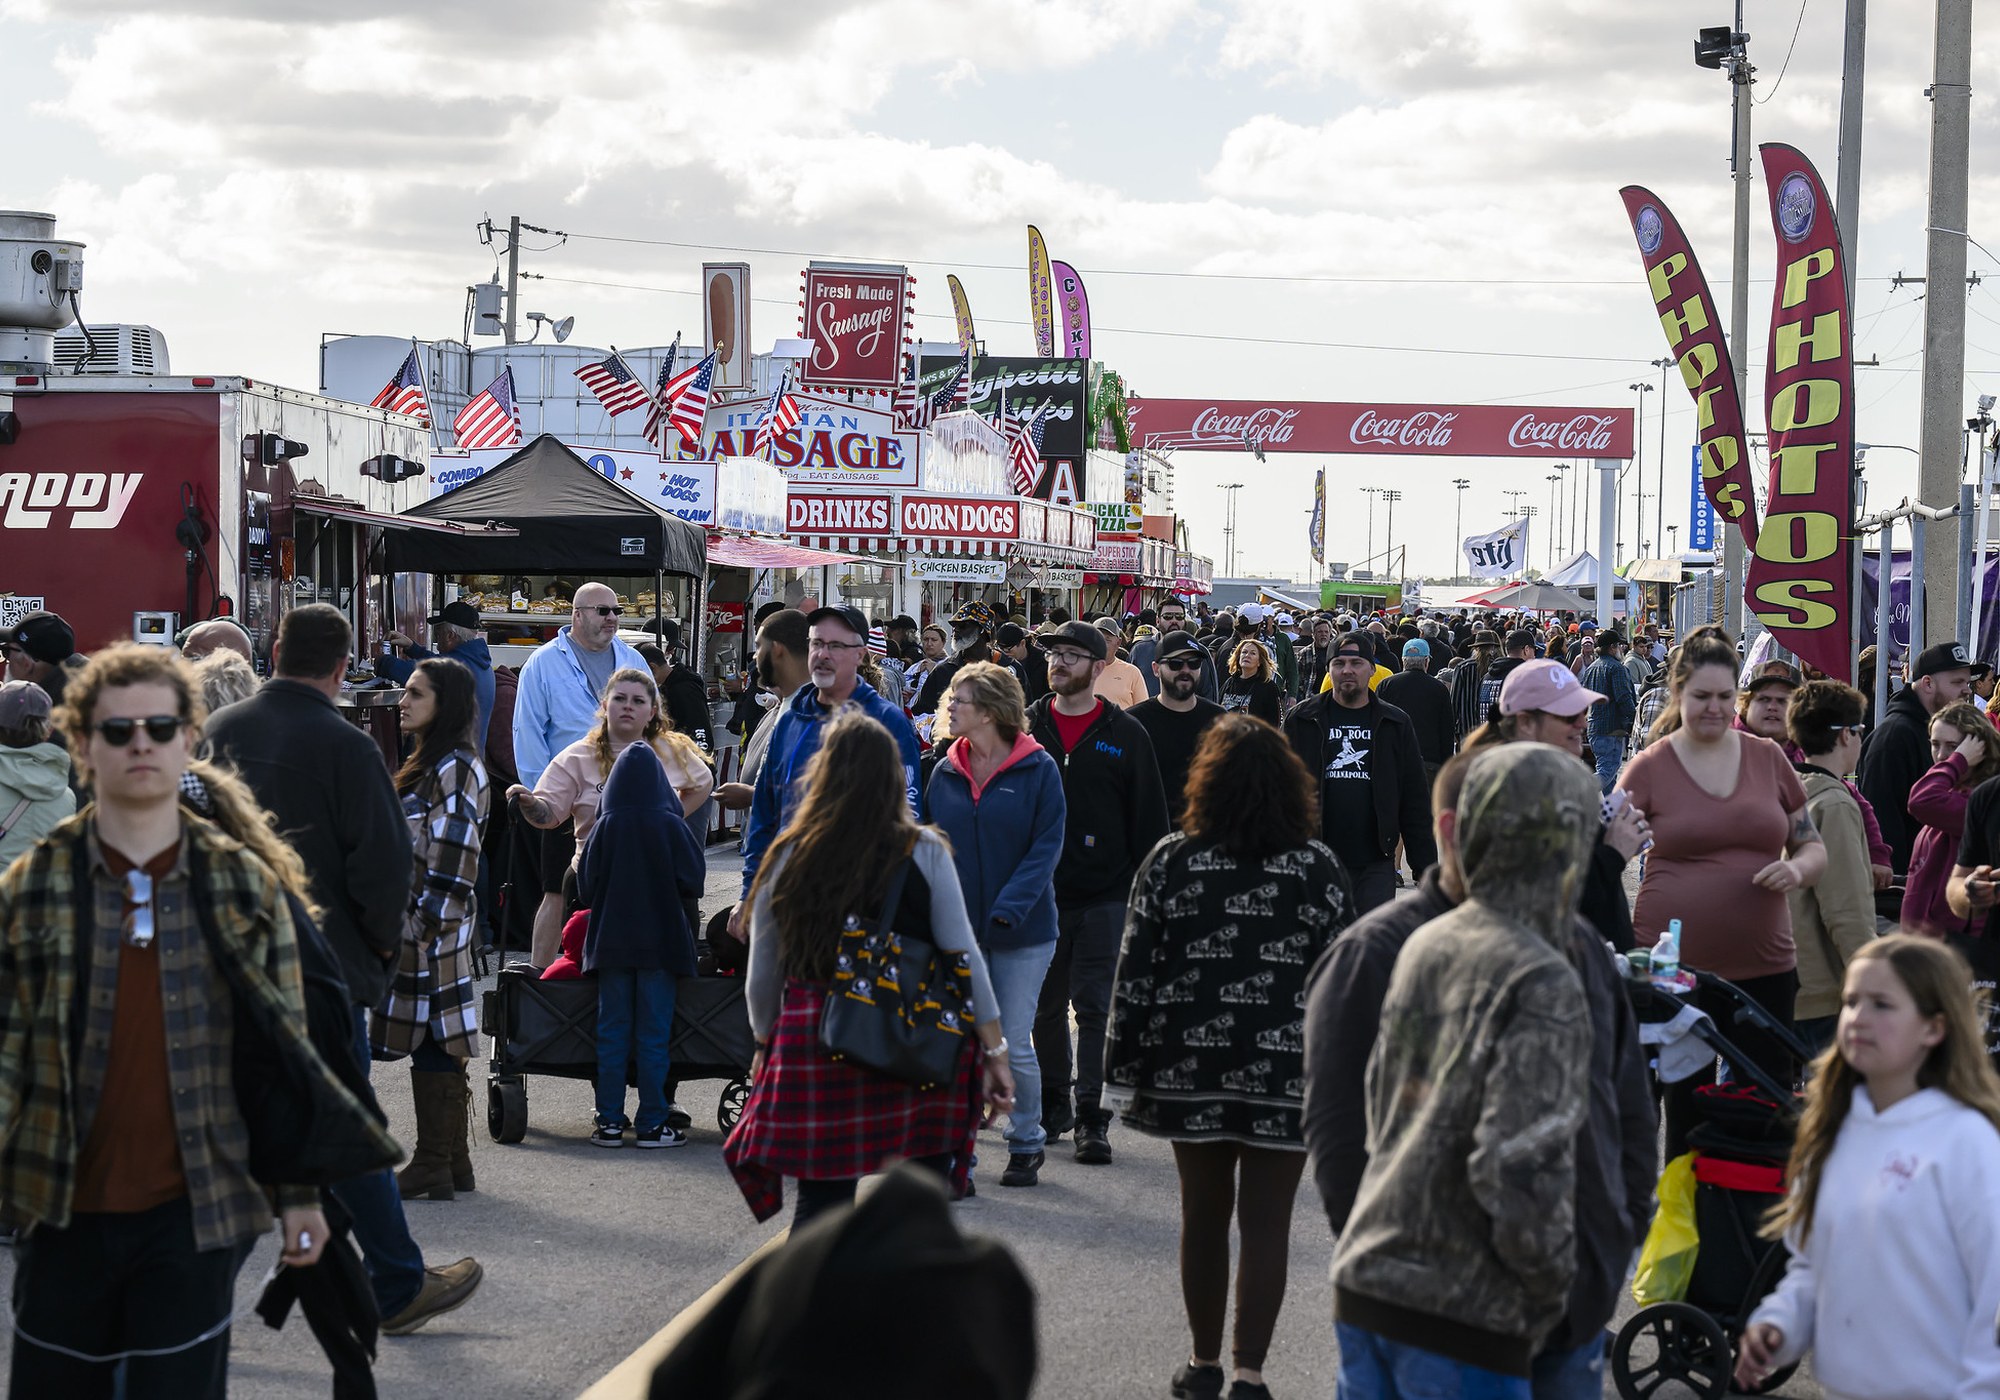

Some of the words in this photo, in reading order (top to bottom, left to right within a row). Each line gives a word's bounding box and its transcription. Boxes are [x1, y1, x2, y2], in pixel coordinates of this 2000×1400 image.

[816, 283, 851, 299] Fresh
[856, 285, 893, 301] Made
[812, 301, 892, 371] Sausage
[1647, 251, 1747, 519] PHOTOS
[727, 413, 859, 431] ITAIAN
[1192, 407, 1301, 443] Coca-Cola
[1350, 410, 1459, 447] Coca-Cola
[1508, 413, 1619, 450] Coca-Cola
[1755, 246, 1842, 630] PHOTOS
[438, 466, 484, 484] COMBO
[668, 473, 700, 489] HOT
[809, 472, 830, 480] EAT
[832, 473, 880, 481] SAUSAGE
[661, 485, 701, 503] DOGS
[677, 509, 711, 522] SLAW
[789, 499, 888, 529] DRINKS
[904, 502, 960, 532] CORN
[961, 505, 1014, 533] DOGS
[1087, 504, 1131, 517] PICKLE
[1097, 518, 1126, 531] IZZA
[1097, 546, 1120, 557] SUPER
[920, 562, 961, 574] CHICKEN
[961, 563, 996, 575] BASKET
[1052, 572, 1076, 582] BASKET
[706, 610, 742, 628] oke
